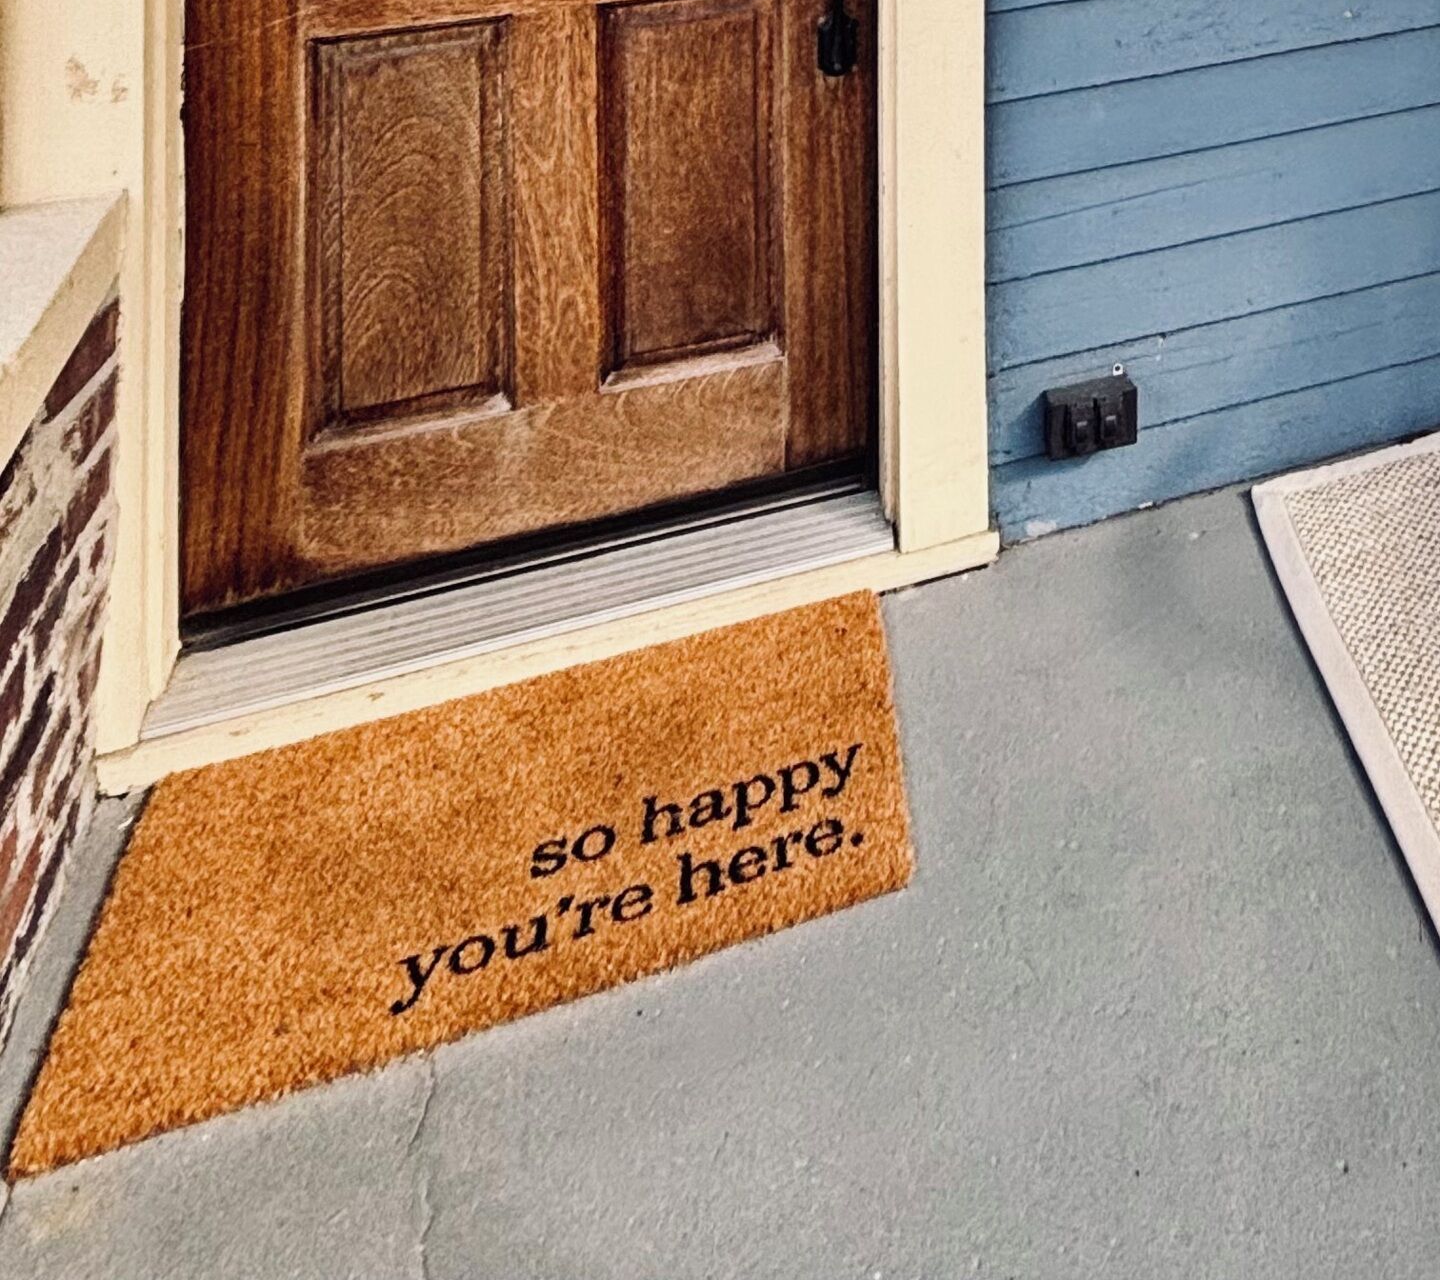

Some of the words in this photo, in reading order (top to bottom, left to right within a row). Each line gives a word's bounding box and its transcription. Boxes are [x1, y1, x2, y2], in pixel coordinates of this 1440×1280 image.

[528, 823, 616, 879] so
[639, 742, 864, 844] happy
[387, 882, 654, 1017] you're
[674, 816, 866, 906] here.
